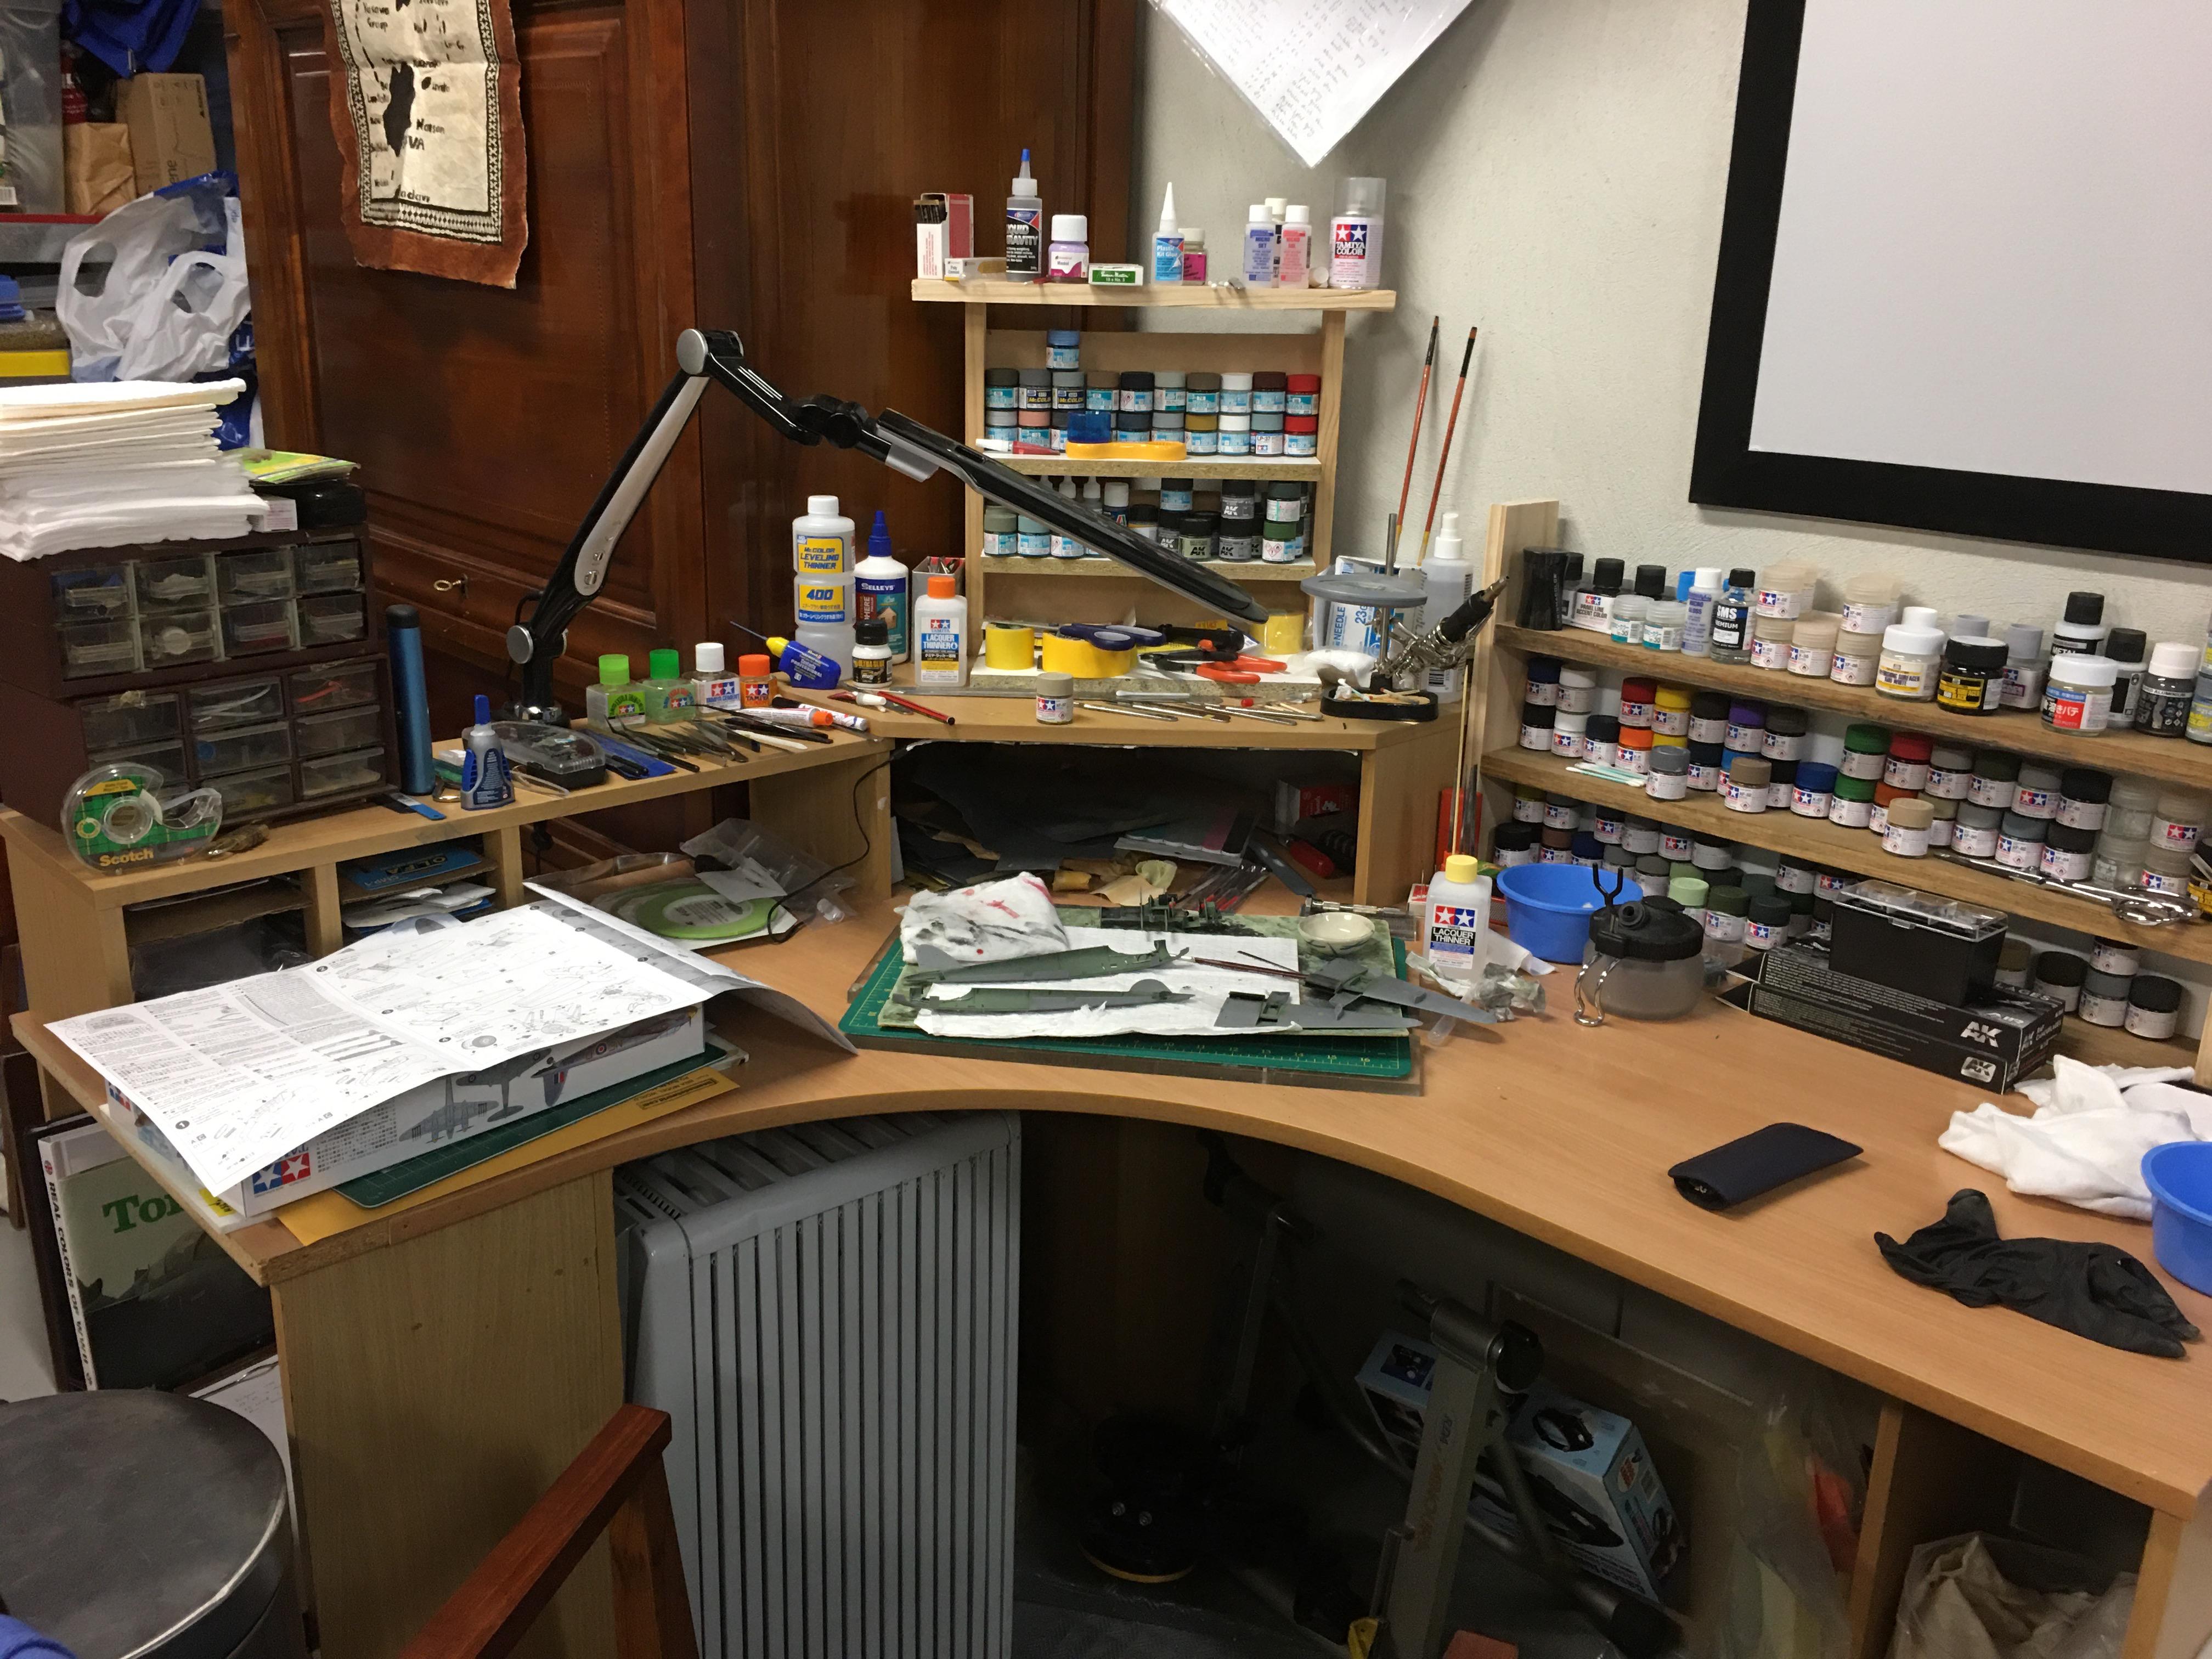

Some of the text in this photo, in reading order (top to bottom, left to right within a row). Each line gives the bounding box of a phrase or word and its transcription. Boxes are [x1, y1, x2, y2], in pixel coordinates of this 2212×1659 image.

[800, 552, 839, 561] LEVELING
[1190, 546, 1206, 556] AK
[1220, 546, 1234, 556] AK
[861, 583, 894, 591] SELLEYS
[807, 589, 833, 600] 400
[1717, 605, 1737, 620] SMS
[1334, 606, 1346, 640] NEEDLE
[99, 848, 154, 867] Scotch
[386, 856, 448, 874] OLFA
[1433, 927, 1474, 939] LACQUER
[1434, 934, 1471, 946] THINNER
[1960, 1021, 2002, 1048] AK
[1965, 1059, 1993, 1076] AK
[48, 1181, 61, 1222] REAL
[58, 1227, 74, 1289] COLORS
[70, 1294, 80, 1317] OF
